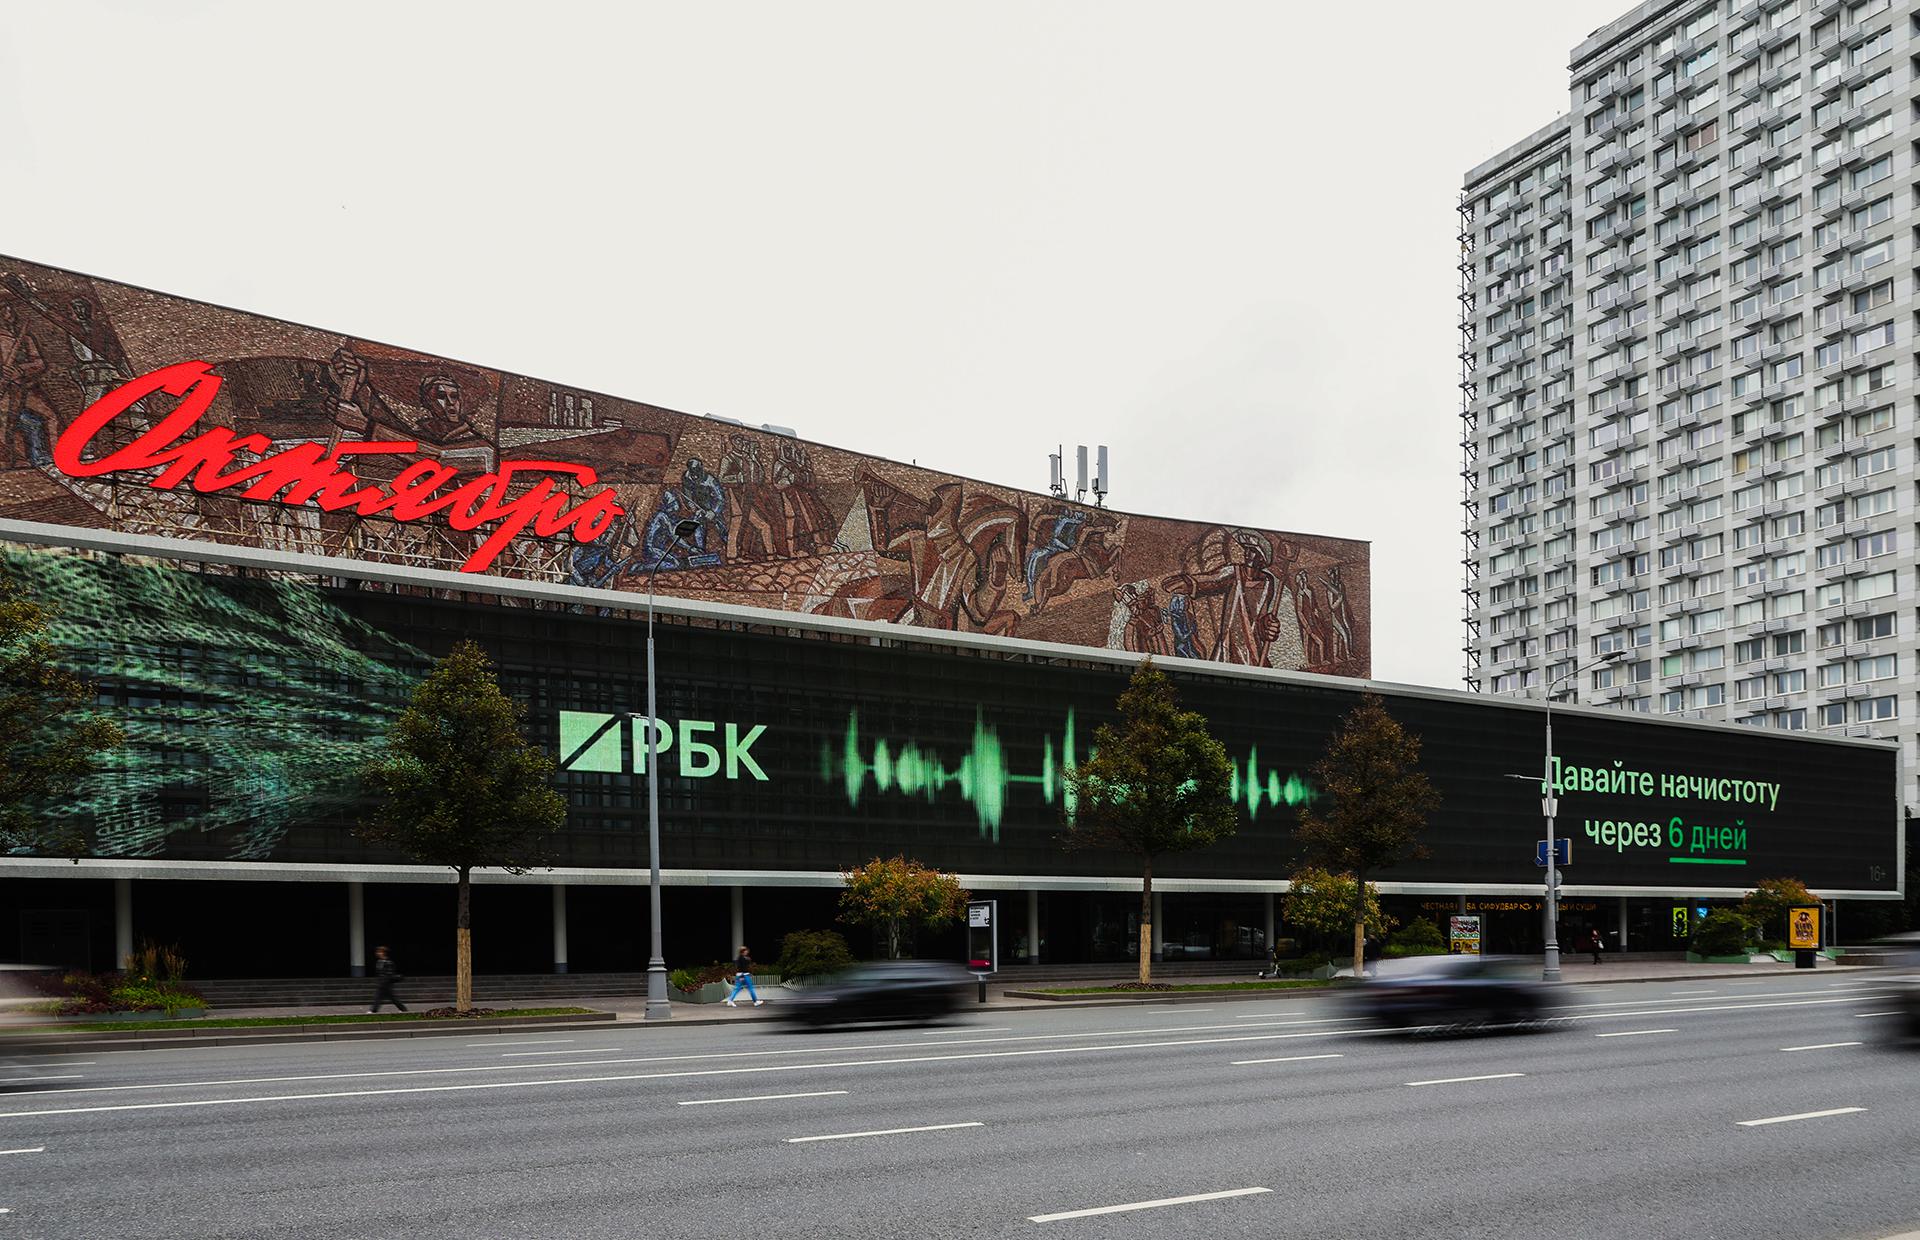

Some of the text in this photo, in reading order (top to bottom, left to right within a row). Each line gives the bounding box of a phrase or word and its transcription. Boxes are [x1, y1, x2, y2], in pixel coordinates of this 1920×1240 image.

[54, 360, 625, 573] Октябрь
[632, 717, 770, 781] РБК
[1541, 756, 1780, 812] Давайте начистоту
[1584, 816, 1747, 854] через 6 дней
[1480, 902, 1519, 911] СИФУДБАР
